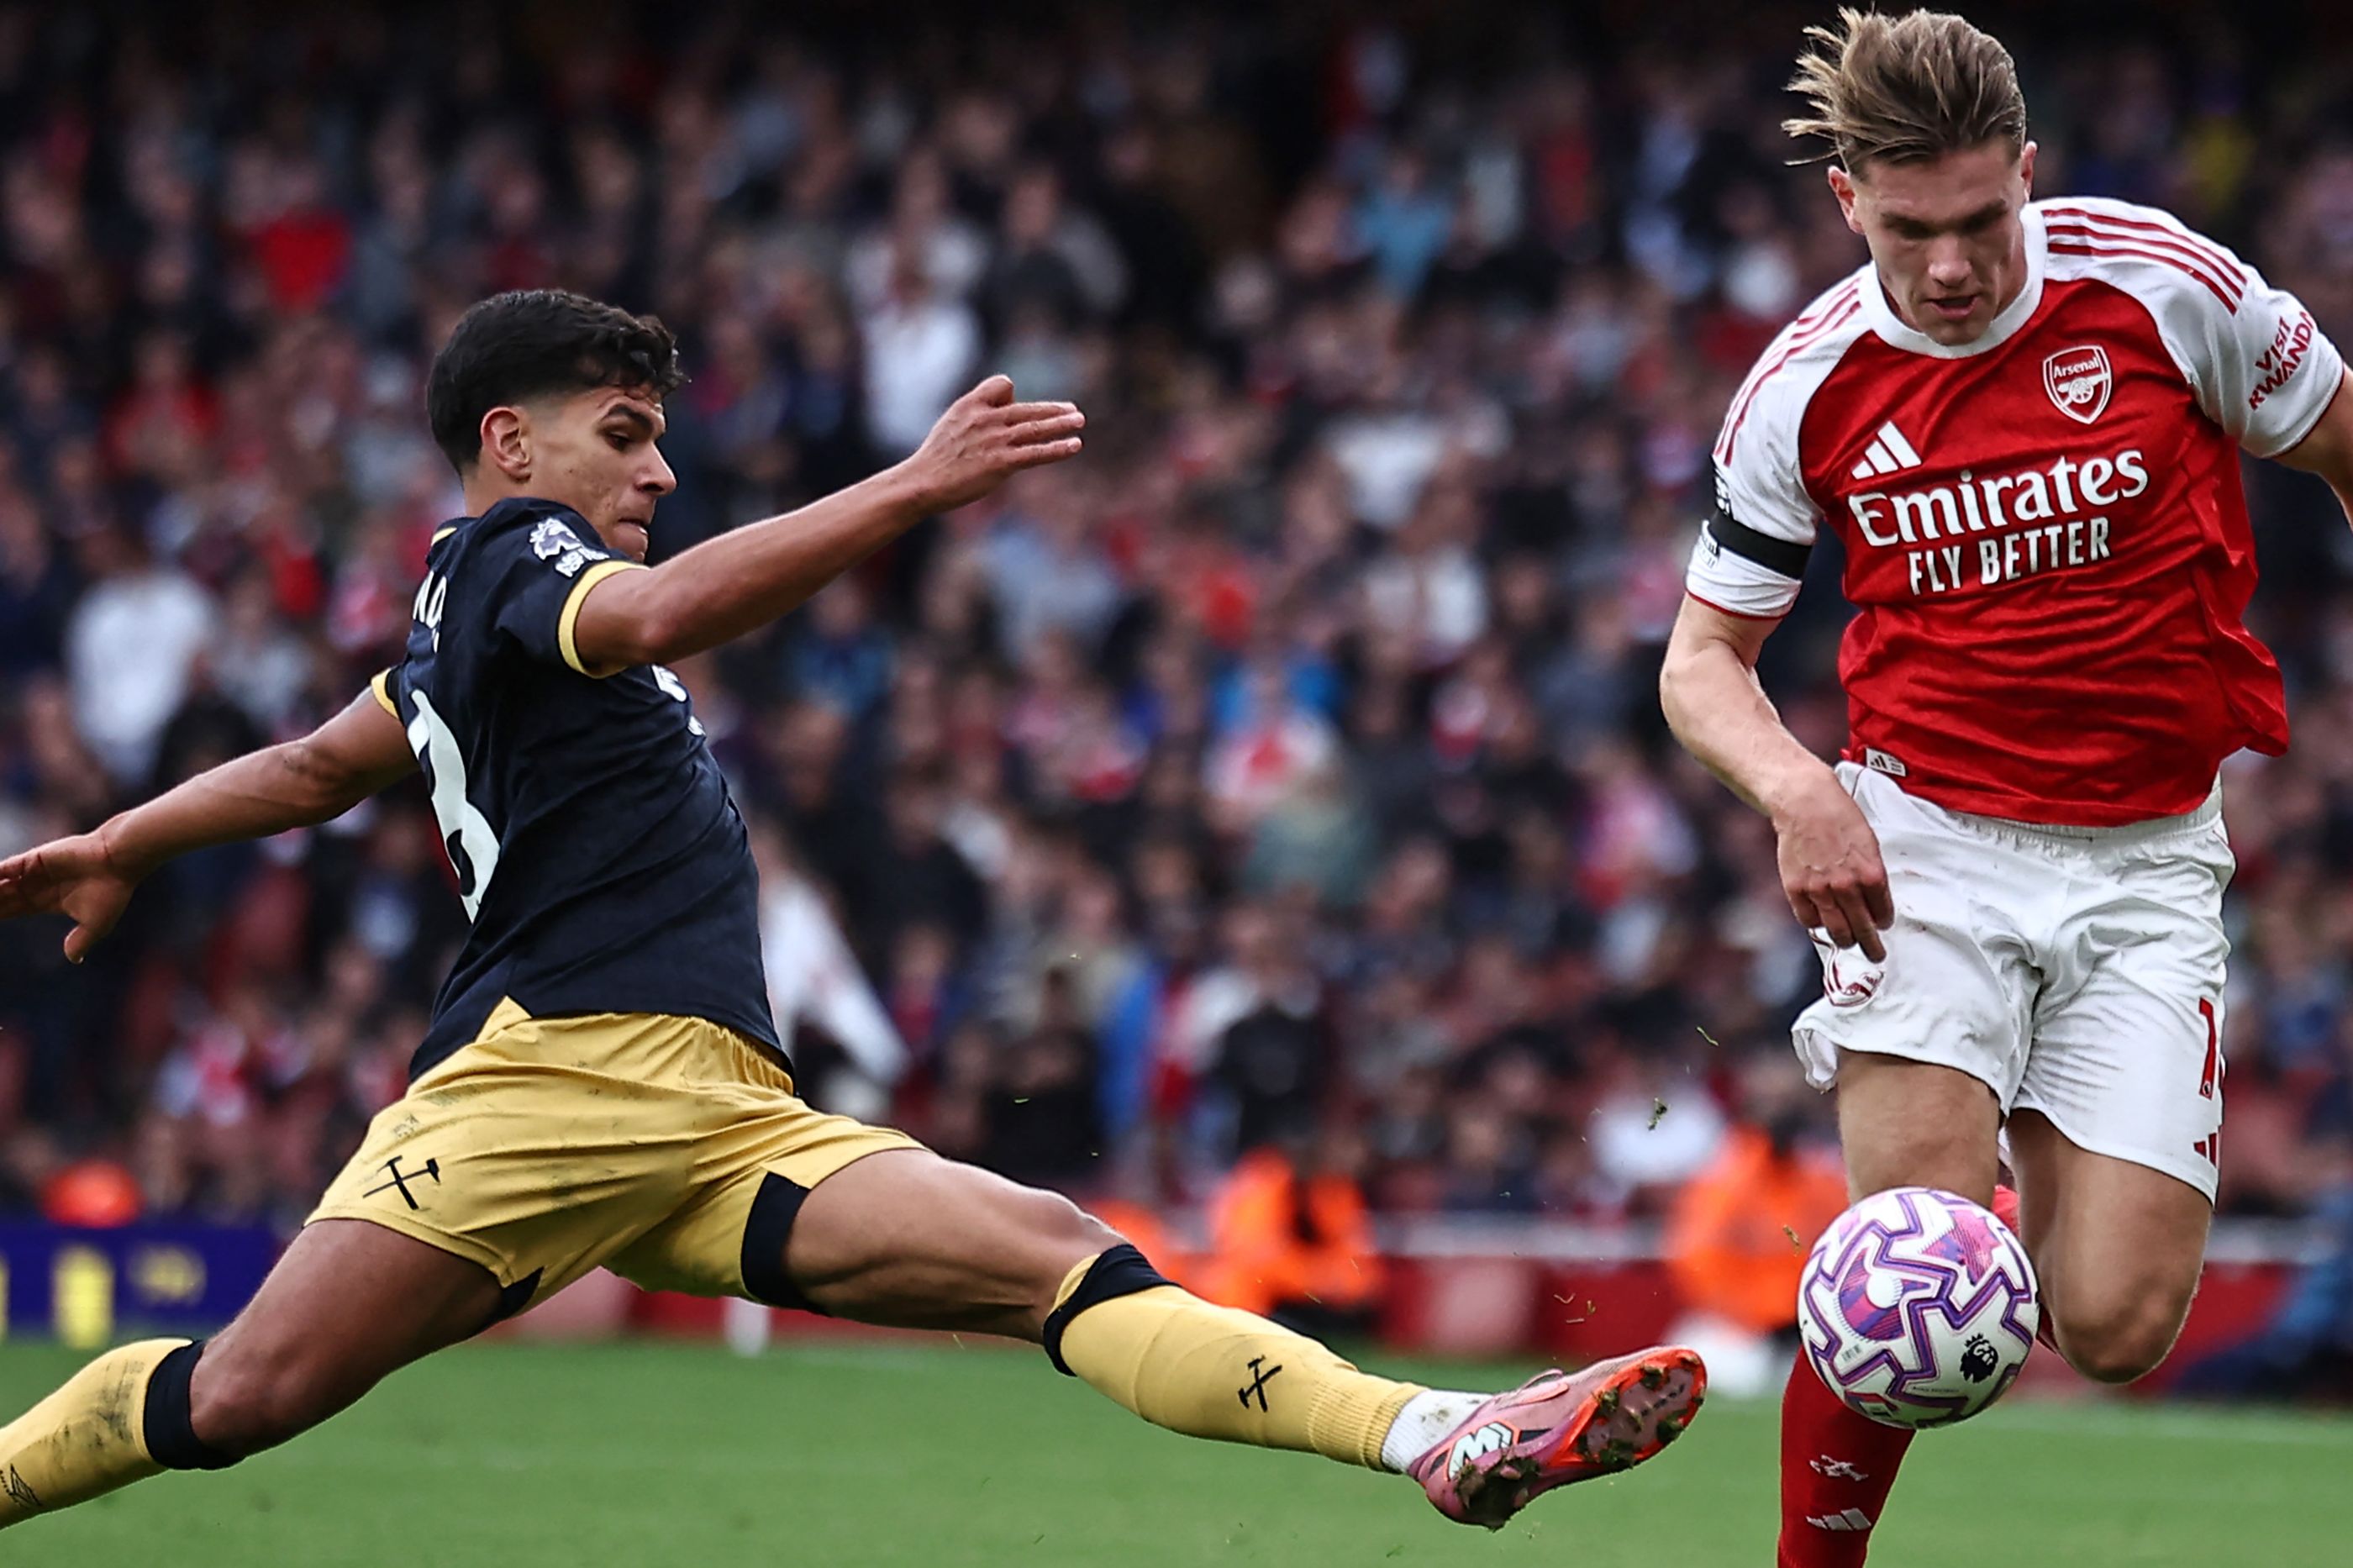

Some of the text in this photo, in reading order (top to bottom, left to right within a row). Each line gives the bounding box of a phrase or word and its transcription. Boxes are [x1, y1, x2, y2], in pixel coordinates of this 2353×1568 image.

[2053, 356, 2100, 379] Arsenal
[2255, 315, 2291, 371] VISIT
[1849, 449, 2149, 547] Emirates
[1908, 516, 2111, 596] FLY BETTER
[2198, 996, 2225, 1101] 1
